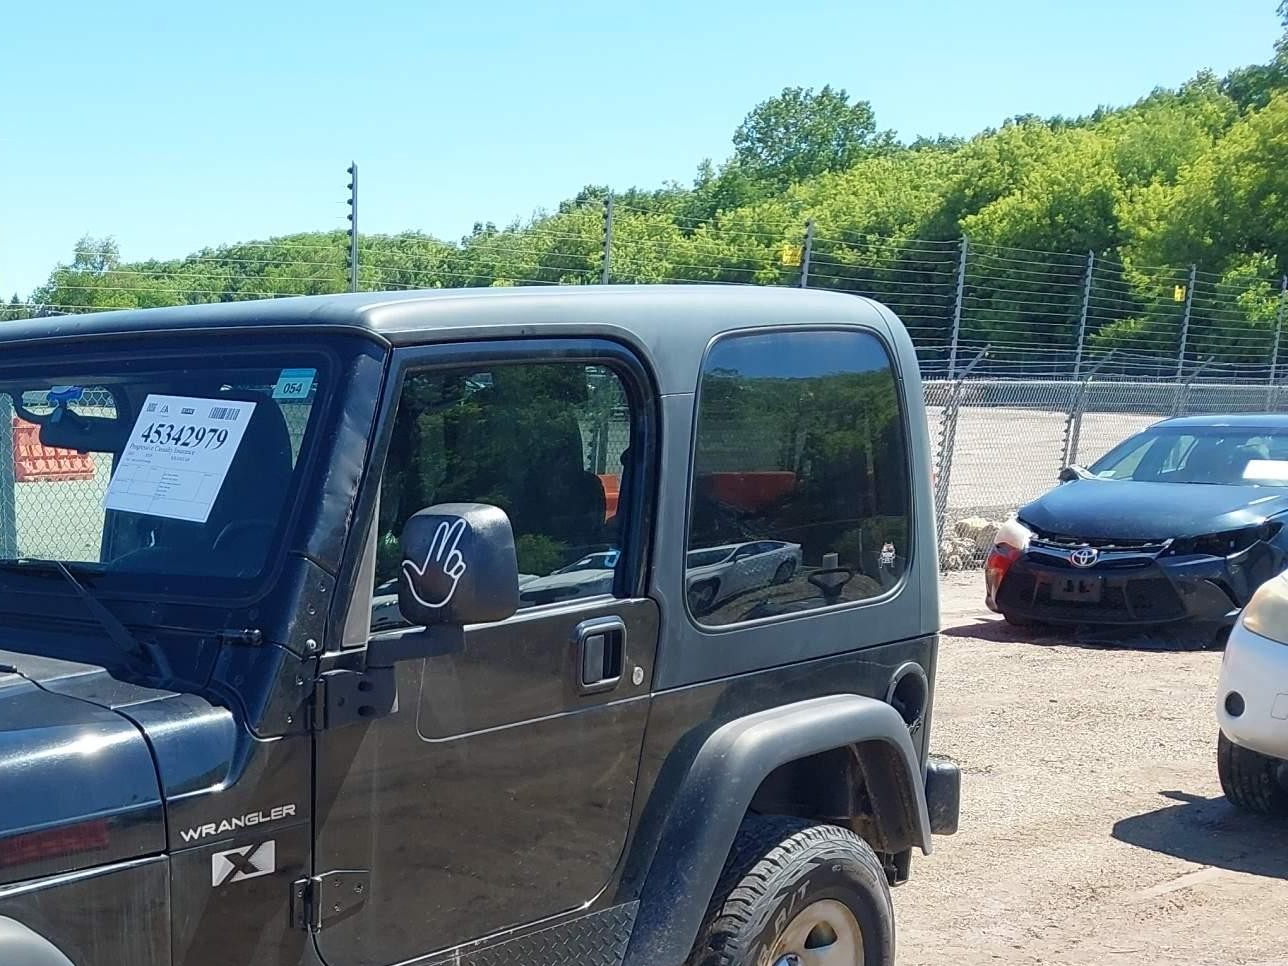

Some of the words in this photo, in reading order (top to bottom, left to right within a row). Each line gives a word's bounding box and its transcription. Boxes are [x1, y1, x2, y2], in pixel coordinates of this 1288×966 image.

[283, 383, 303, 393] 054
[141, 423, 229, 450] 45342979
[180, 804, 296, 842] WRANGLER
[212, 840, 275, 887] X
